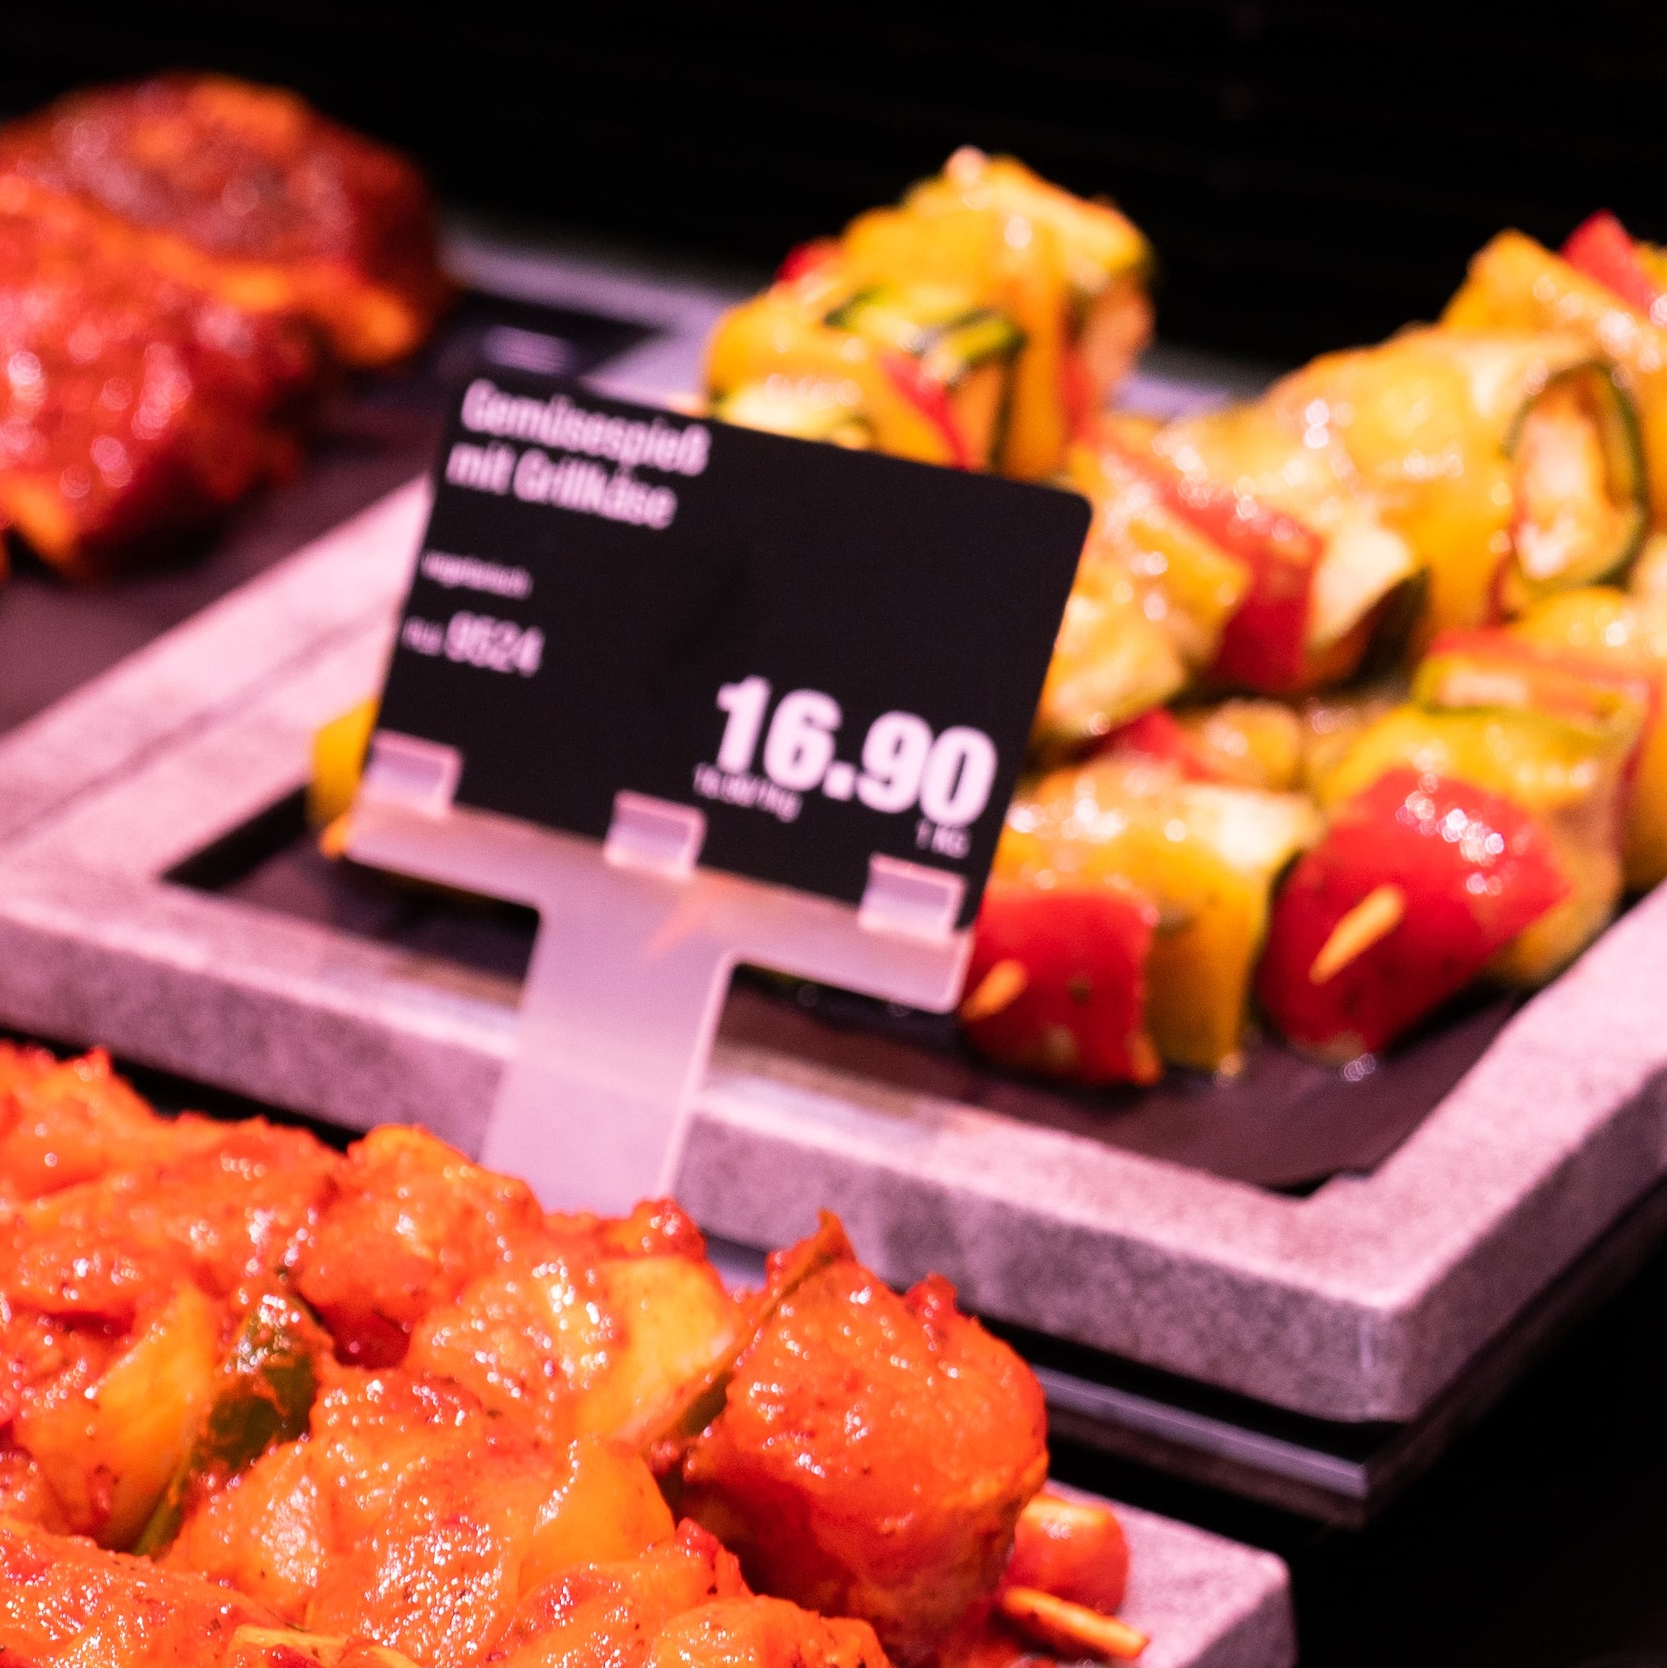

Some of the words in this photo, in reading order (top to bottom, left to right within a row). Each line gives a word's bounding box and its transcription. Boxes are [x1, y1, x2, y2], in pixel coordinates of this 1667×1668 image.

[461, 379, 711, 475] Gemüsespieß
[446, 445, 515, 493] mit
[513, 450, 675, 528] Grillkäse
[718, 679, 996, 826] 16.90
